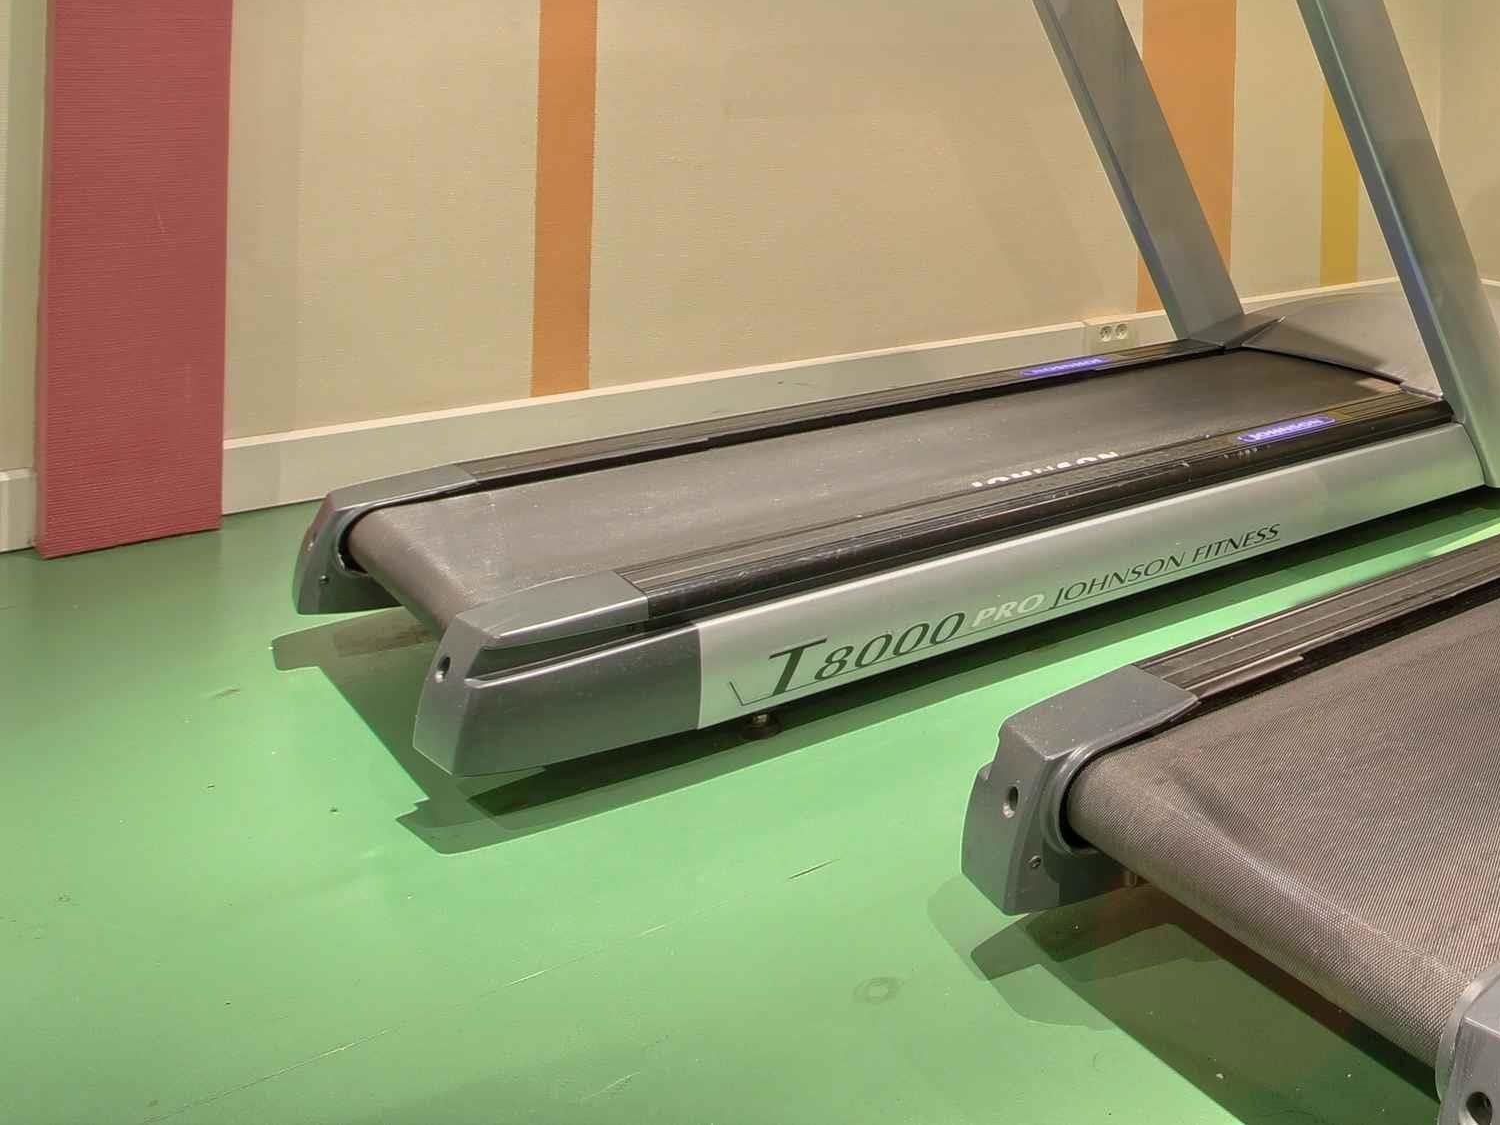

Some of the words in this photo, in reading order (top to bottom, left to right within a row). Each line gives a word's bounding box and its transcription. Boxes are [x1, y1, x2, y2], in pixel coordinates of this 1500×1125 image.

[769, 612, 965, 697] T8000
[971, 594, 1045, 628] PRO
[1049, 551, 1186, 609] JOHNSON
[1191, 523, 1281, 563] FITNESS
